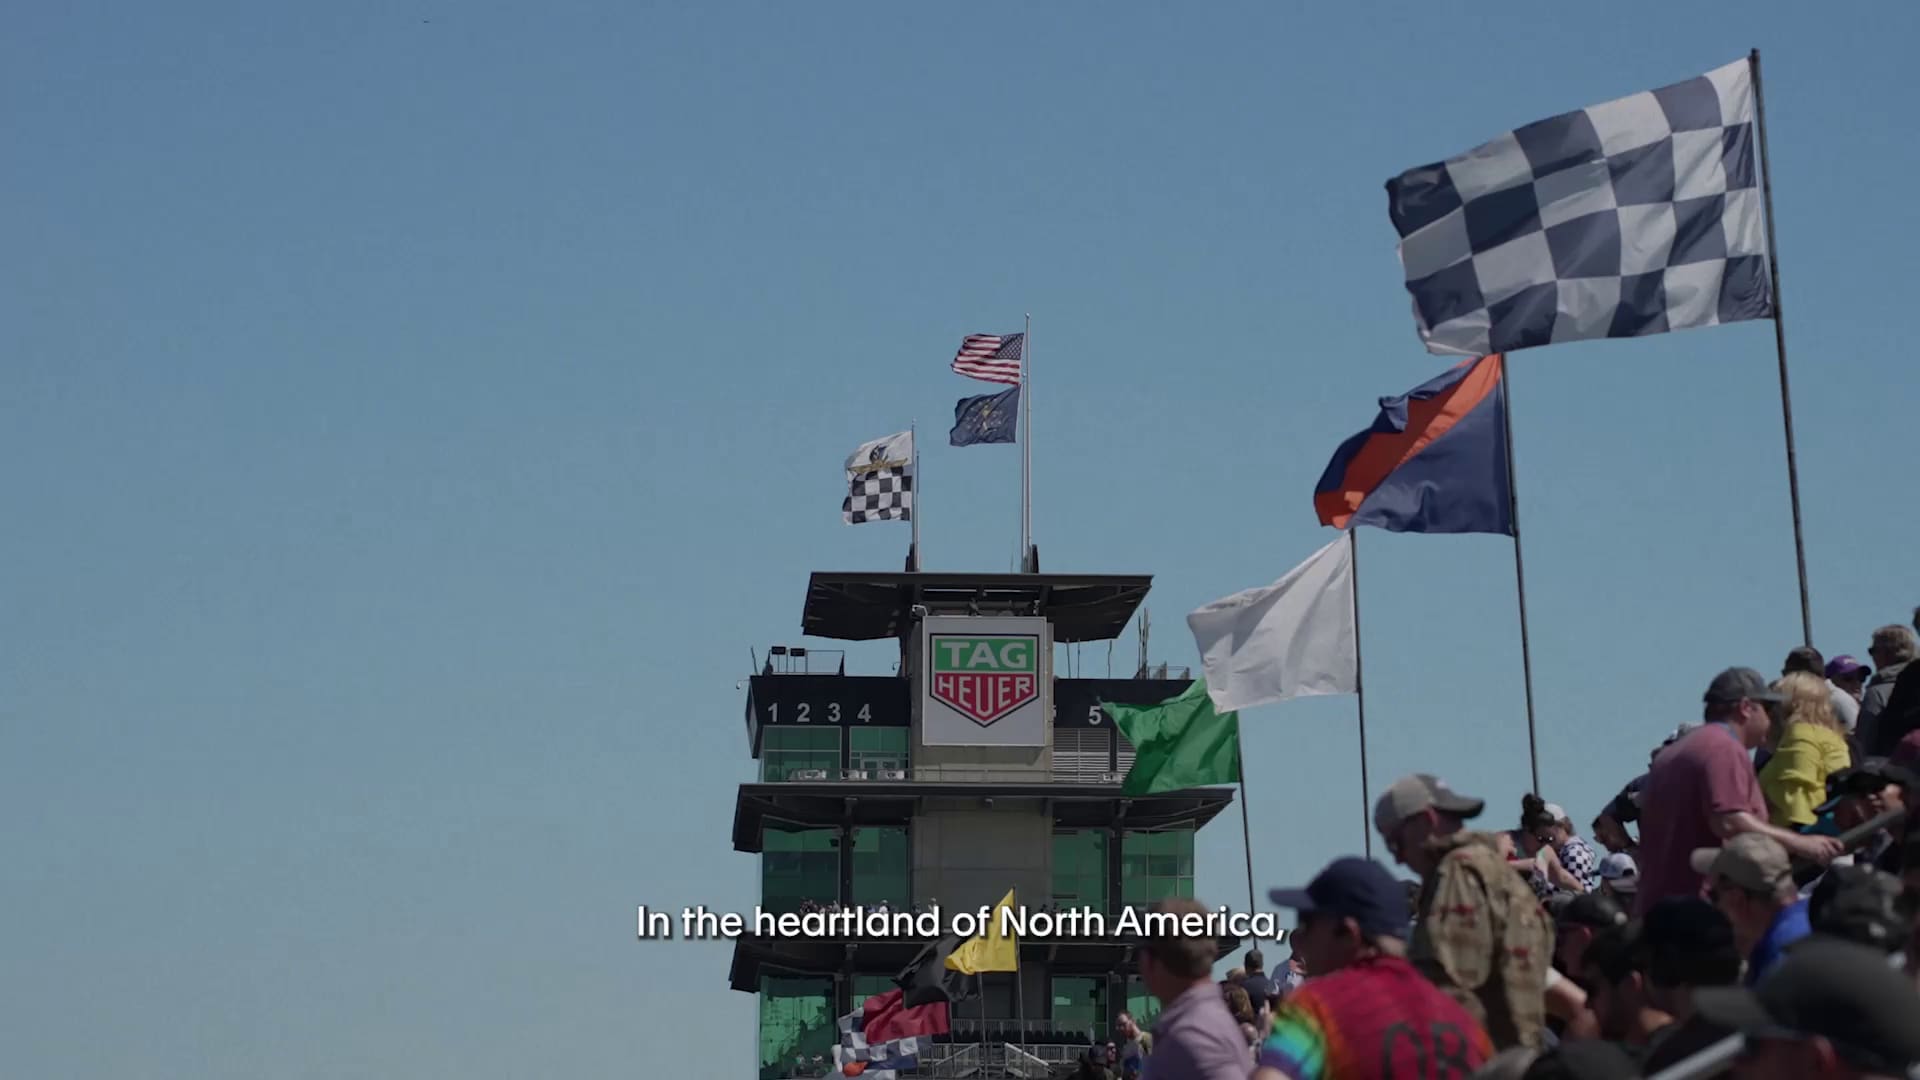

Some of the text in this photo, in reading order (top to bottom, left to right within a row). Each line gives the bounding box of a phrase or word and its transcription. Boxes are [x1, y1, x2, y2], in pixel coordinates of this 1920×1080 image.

[940, 641, 1027, 668] TAG
[938, 675, 1031, 717] HEUER
[767, 702, 872, 723] 1 2 3 4
[1088, 705, 1102, 725] 5
